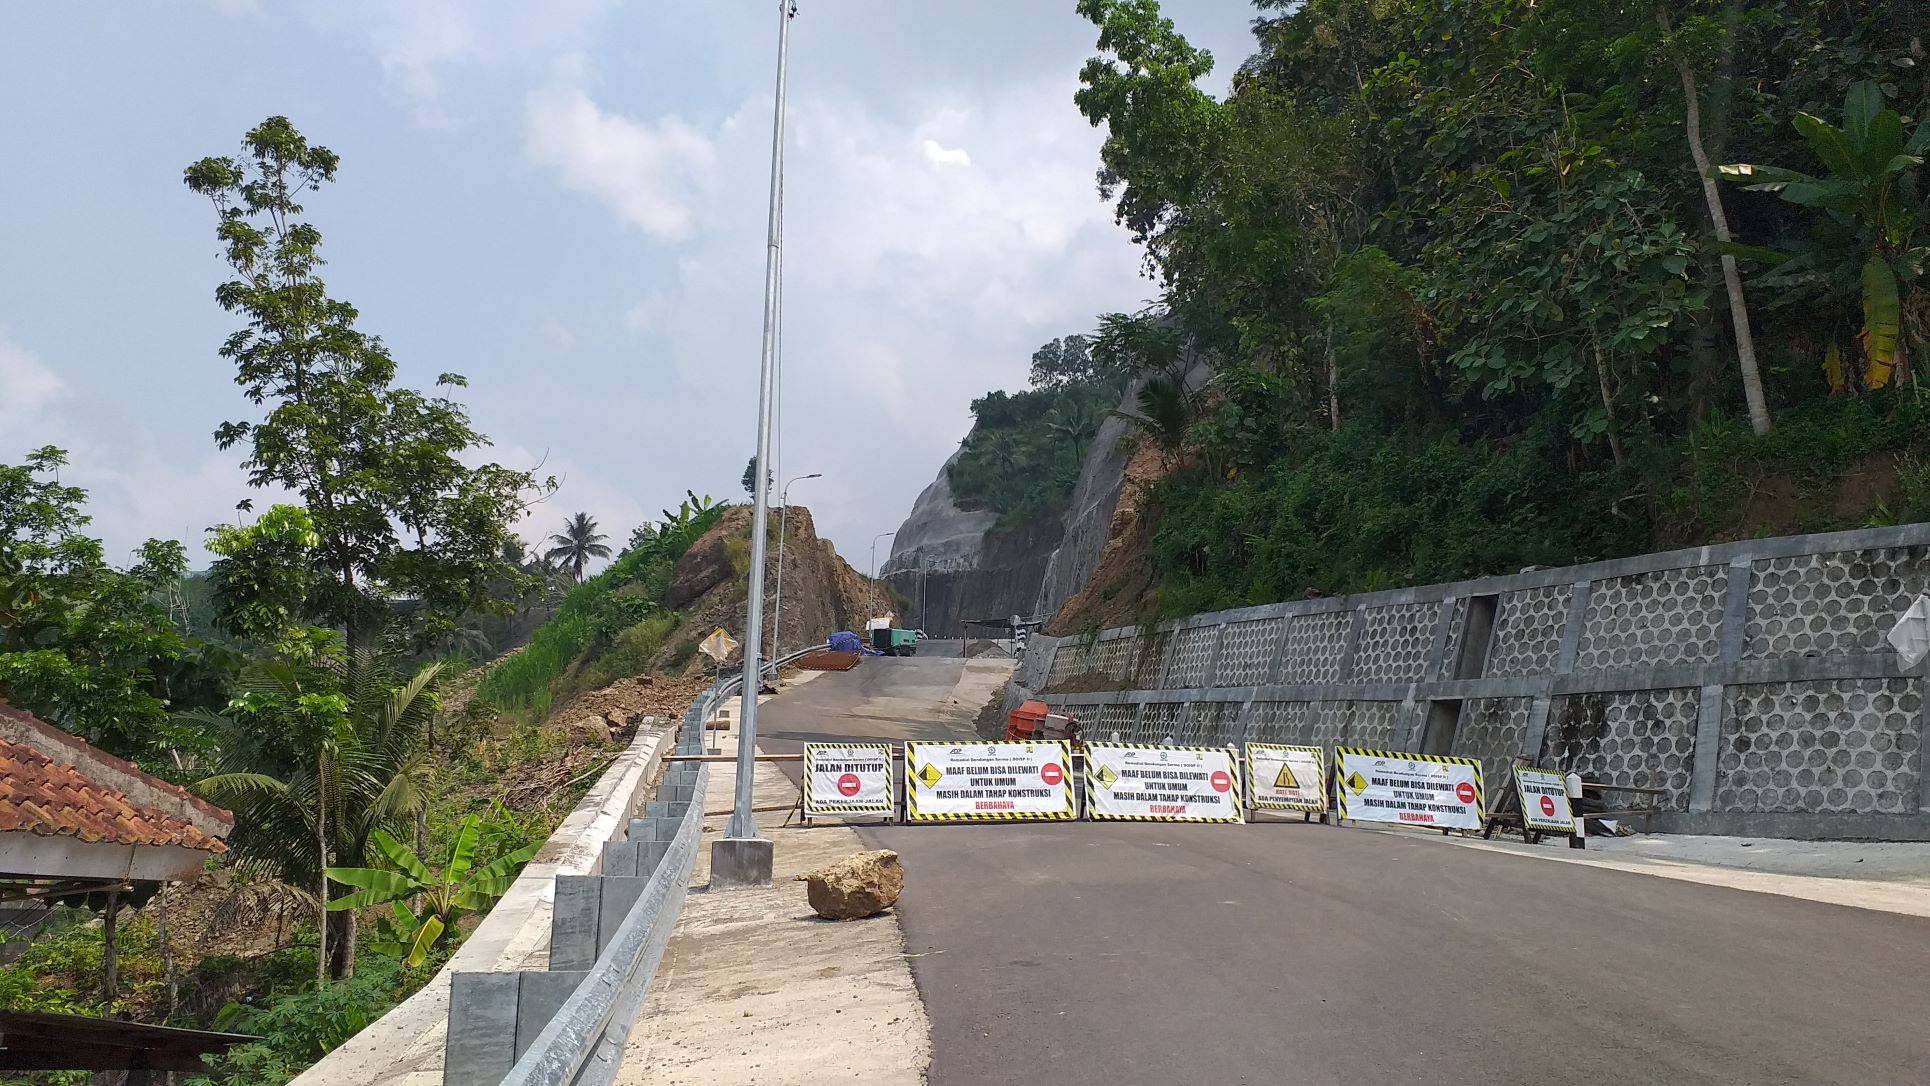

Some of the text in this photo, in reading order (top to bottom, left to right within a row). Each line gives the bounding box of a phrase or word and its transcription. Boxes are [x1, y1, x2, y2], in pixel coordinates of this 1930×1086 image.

[815, 763, 884, 772] JALAN DITUTUP
[946, 766, 1039, 775] MAAF BELUM BISA DILEWATI
[1121, 769, 1209, 781] MAAF BELUM BISA DILEWATI
[970, 777, 1016, 786] UNTUK UMUM
[1144, 782, 1188, 791] UNTUK UMUM
[1371, 777, 1455, 792] MAAF BELUM BISA DILEWATI
[936, 789, 1051, 799] MASIH DALAM TAHAP KONSTRUKSI
[1392, 790, 1435, 800] UNTUK UMUM
[1524, 785, 1564, 796] JALAN DITUTUP
[1113, 791, 1221, 804] MASIH DALAM TAHAP KONSTRUKSI
[975, 801, 1015, 810] BERBAHAYA
[1149, 804, 1186, 814] BERBAHAYA
[1363, 798, 1467, 814] MASIH DALAM TAHAP KONSTRUKSI
[1399, 812, 1435, 822] BERBAHAYA
